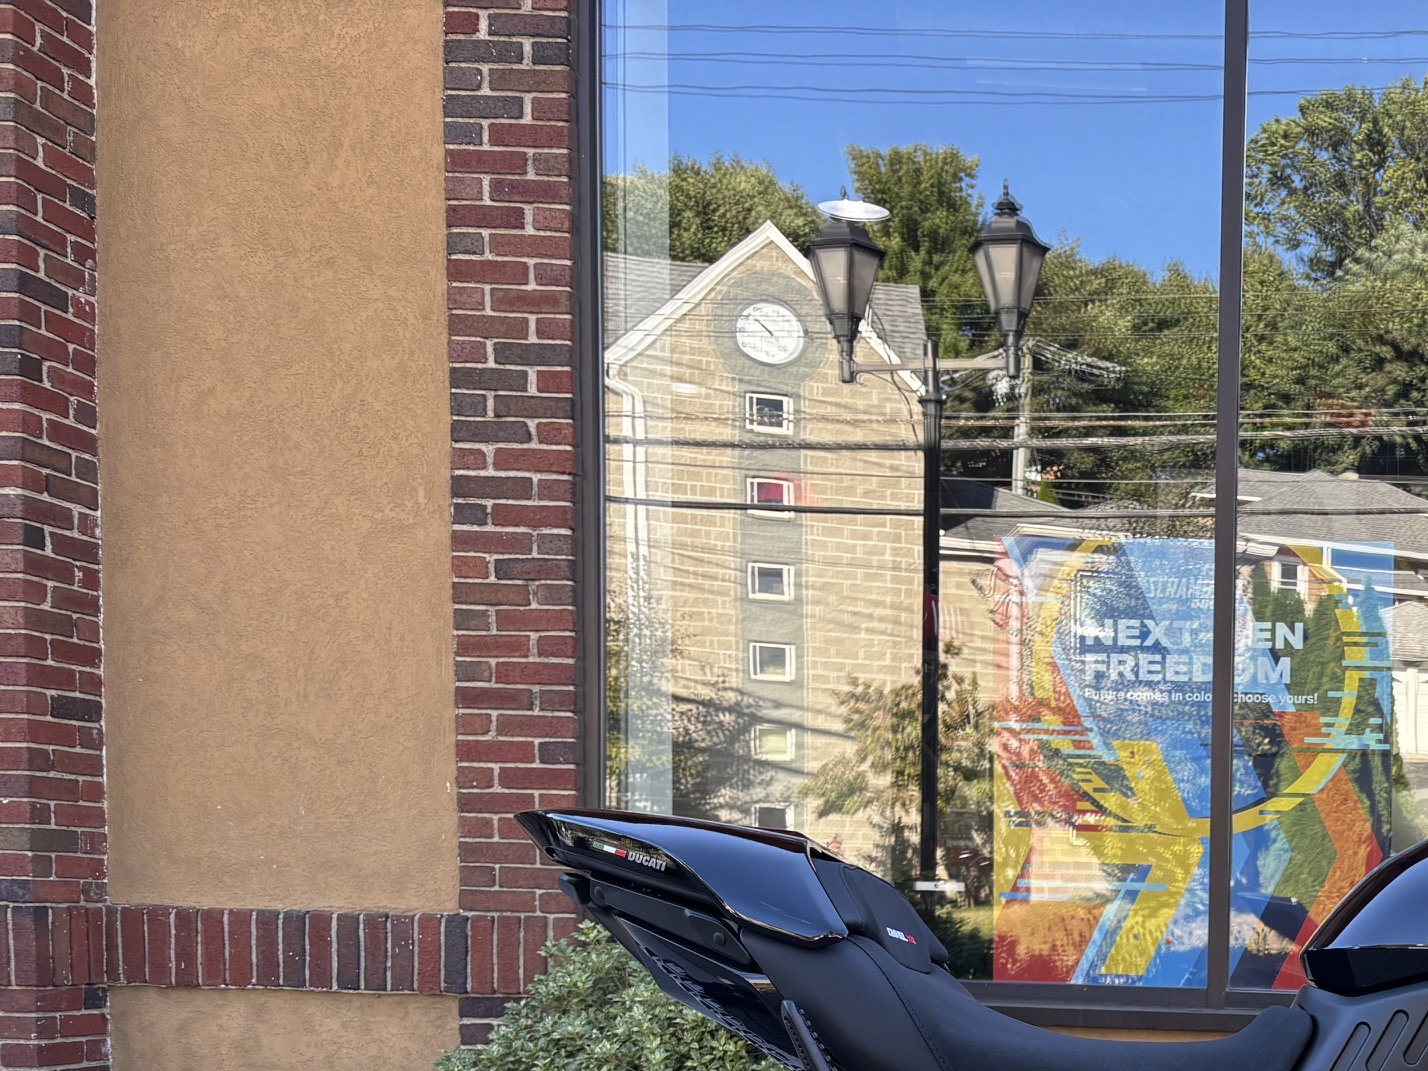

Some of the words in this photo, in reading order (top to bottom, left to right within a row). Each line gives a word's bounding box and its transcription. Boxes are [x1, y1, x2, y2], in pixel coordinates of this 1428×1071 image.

[1171, 690, 1183, 701] in
[1185, 690, 1214, 702] colo
[1279, 692, 1318, 706] yours!
[627, 851, 667, 872] DUCATI
